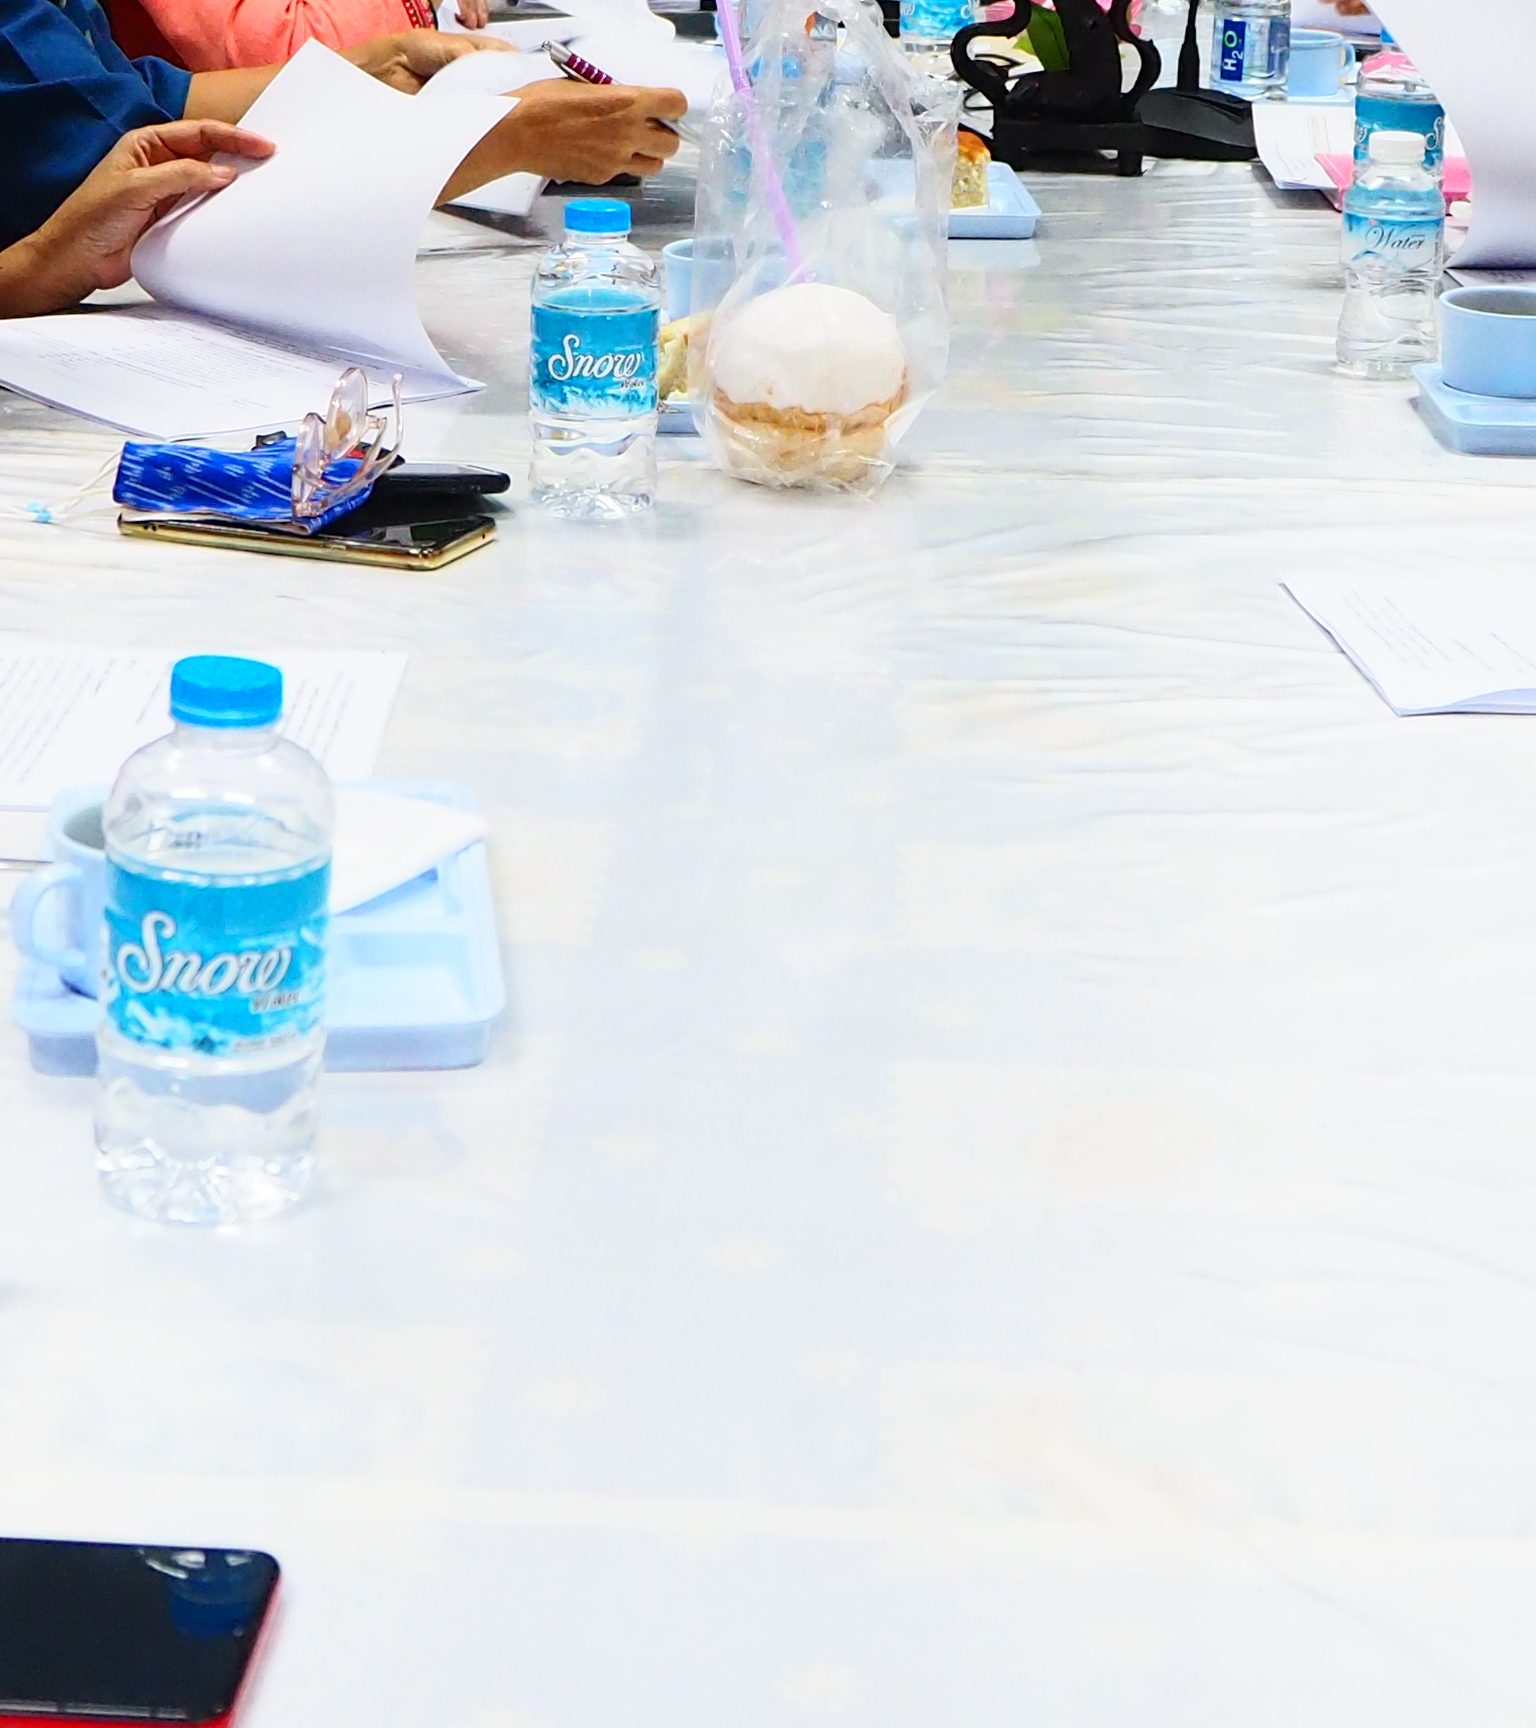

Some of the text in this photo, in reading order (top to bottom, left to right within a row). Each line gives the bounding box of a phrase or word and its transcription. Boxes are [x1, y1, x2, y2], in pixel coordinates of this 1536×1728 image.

[1366, 225, 1426, 251] Water
[547, 333, 644, 381] Snow
[116, 909, 293, 996] Snow
